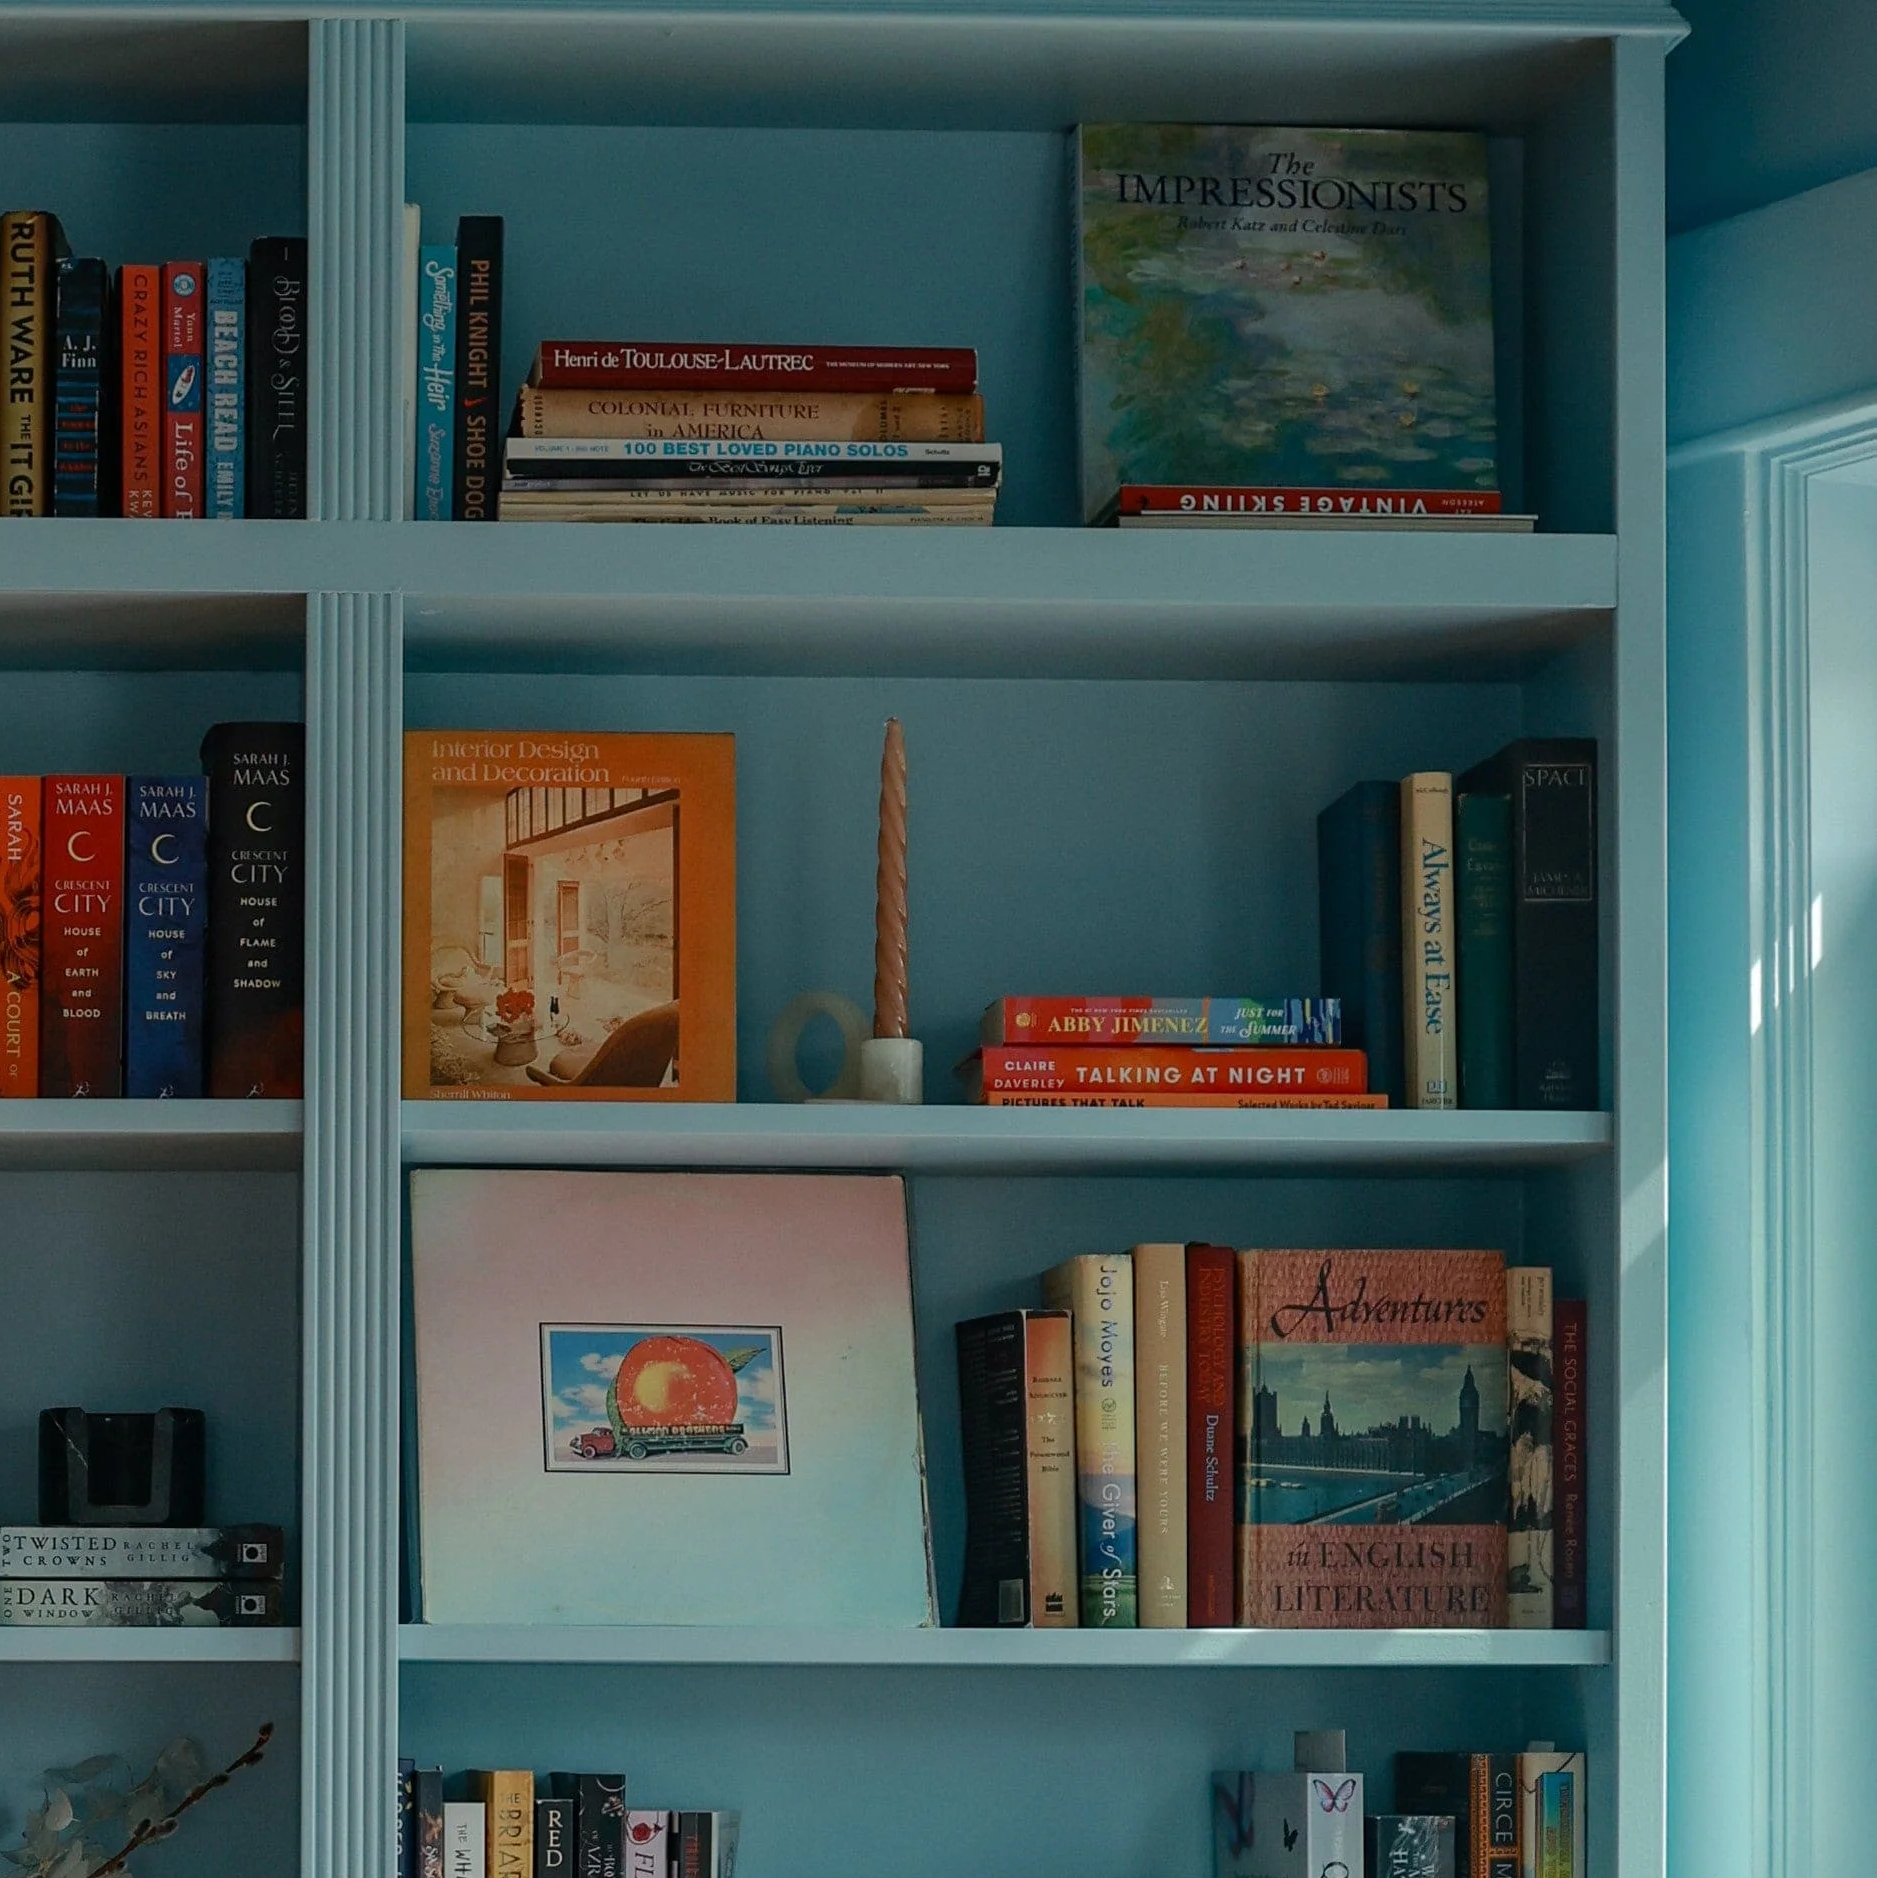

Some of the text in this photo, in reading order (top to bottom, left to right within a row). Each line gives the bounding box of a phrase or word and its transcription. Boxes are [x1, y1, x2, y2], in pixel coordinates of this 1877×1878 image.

[1268, 151, 1314, 175] The
[1116, 173, 1468, 213] IMPRESSIONISTS
[10, 223, 34, 404] RUTH WARE
[467, 260, 489, 388] PHIL KNIGHT
[553, 348, 814, 373] Henri de TOULOUSE-LAUTREC
[213, 311, 237, 453] BEACH READ
[624, 443, 656, 457] 100
[663, 443, 708, 457] BEST
[717, 443, 776, 457] LOVED
[784, 443, 839, 457] PIANO
[847, 443, 908, 458] SOLOS
[464, 415, 486, 519] SHOE DOG
[1179, 494, 1426, 514] VINTAGE SKIING
[432, 740, 599, 763] Interior Design
[432, 762, 610, 783] and Decoration
[53, 894, 113, 914] CITY
[1422, 838, 1451, 1036] Always at Ease
[1047, 1016, 1208, 1035] ABBY JIMENEZ
[1005, 1061, 1056, 1071] CLAIRE
[1075, 1066, 1305, 1084] TALKING AT NIGHT
[994, 1078, 1064, 1089] DAVERLEY
[1271, 1258, 1488, 1340] Adventures
[1095, 1265, 1117, 1388] Jojo Moyes
[1205, 1414, 1219, 1501] Duane Schultz
[1101, 1440, 1121, 1617] The Giver of Stars
[14, 1536, 117, 1551] TWISTED
[1288, 1541, 1473, 1569] in ENGLISH
[22, 1555, 107, 1567] CROWNS
[18, 1587, 99, 1606] DARK
[1274, 1585, 1489, 1613] LITERATURE
[1495, 1772, 1513, 1843] CIRCE
